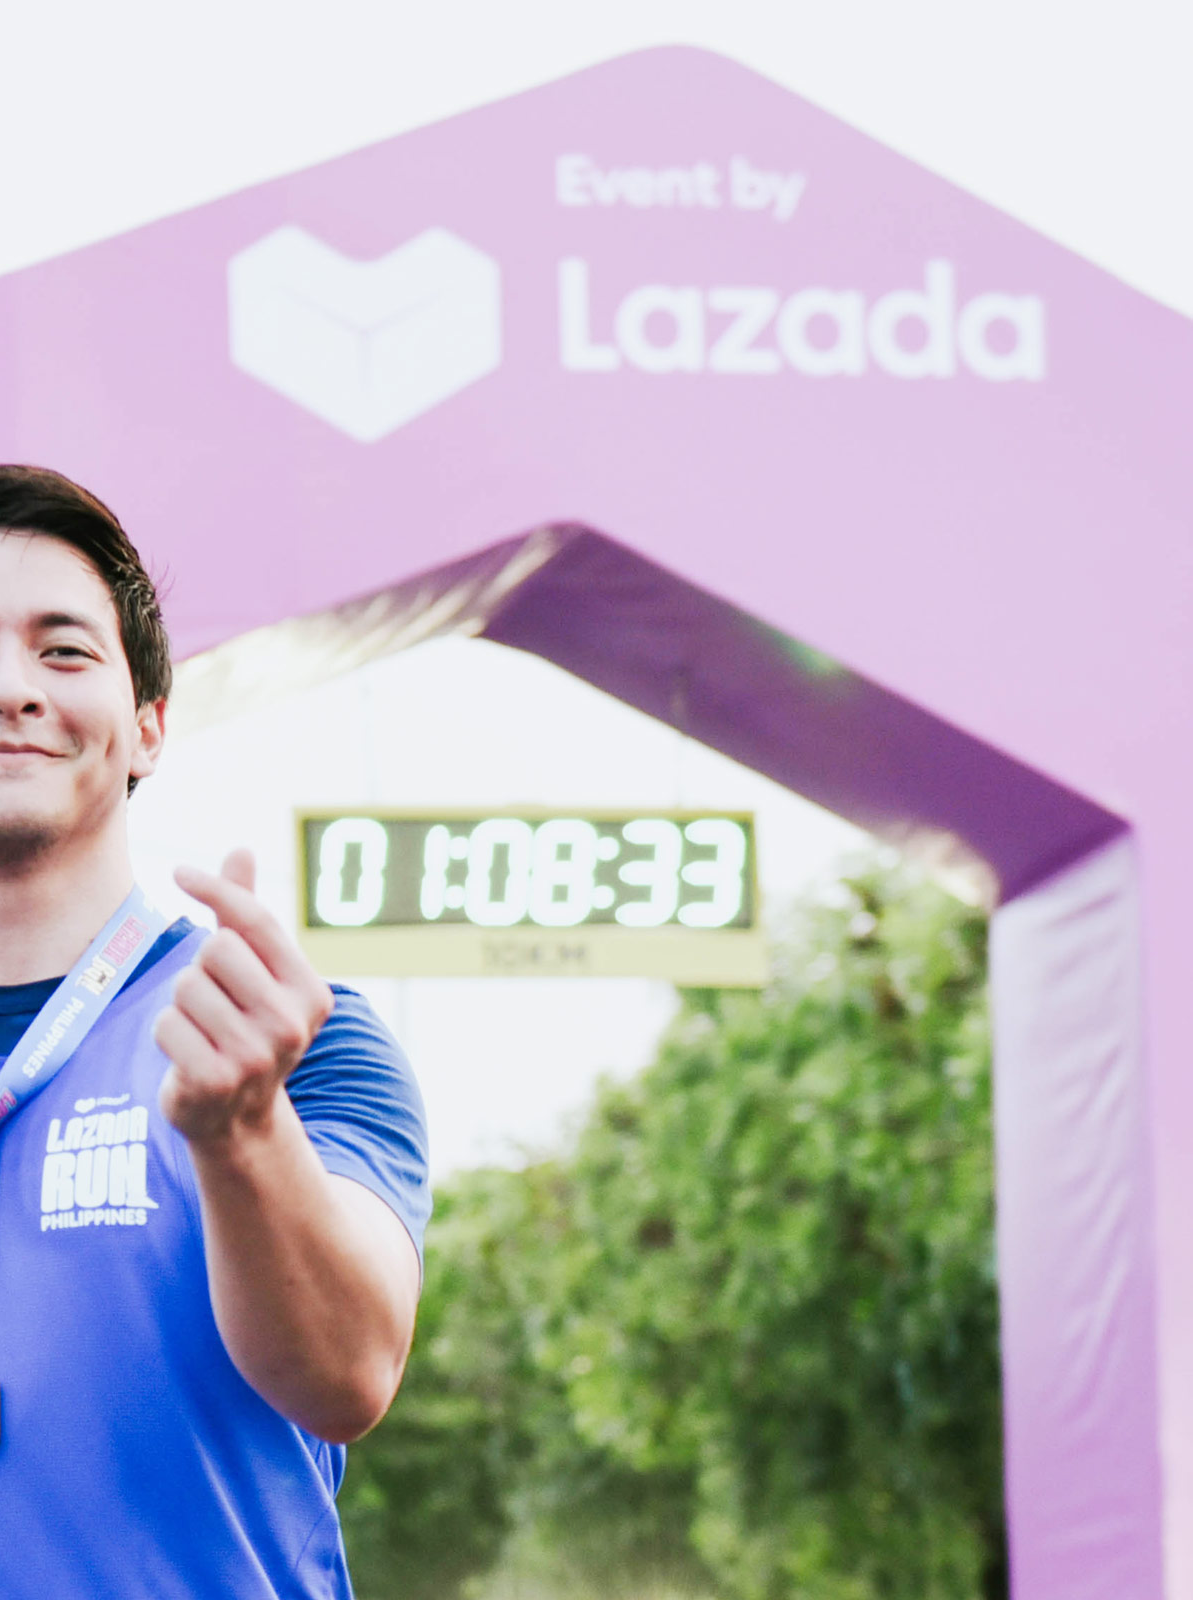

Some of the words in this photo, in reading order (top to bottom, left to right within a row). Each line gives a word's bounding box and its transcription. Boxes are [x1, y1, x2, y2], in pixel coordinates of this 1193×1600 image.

[555, 154, 721, 209] Event
[731, 155, 806, 221] by
[557, 257, 1046, 382] Lazada
[21, 996, 86, 1079] PHILIPPINES
[46, 1105, 149, 1154] LAZADA
[40, 1142, 150, 1213] RUN
[40, 1208, 148, 1232] PHILIPPINES
